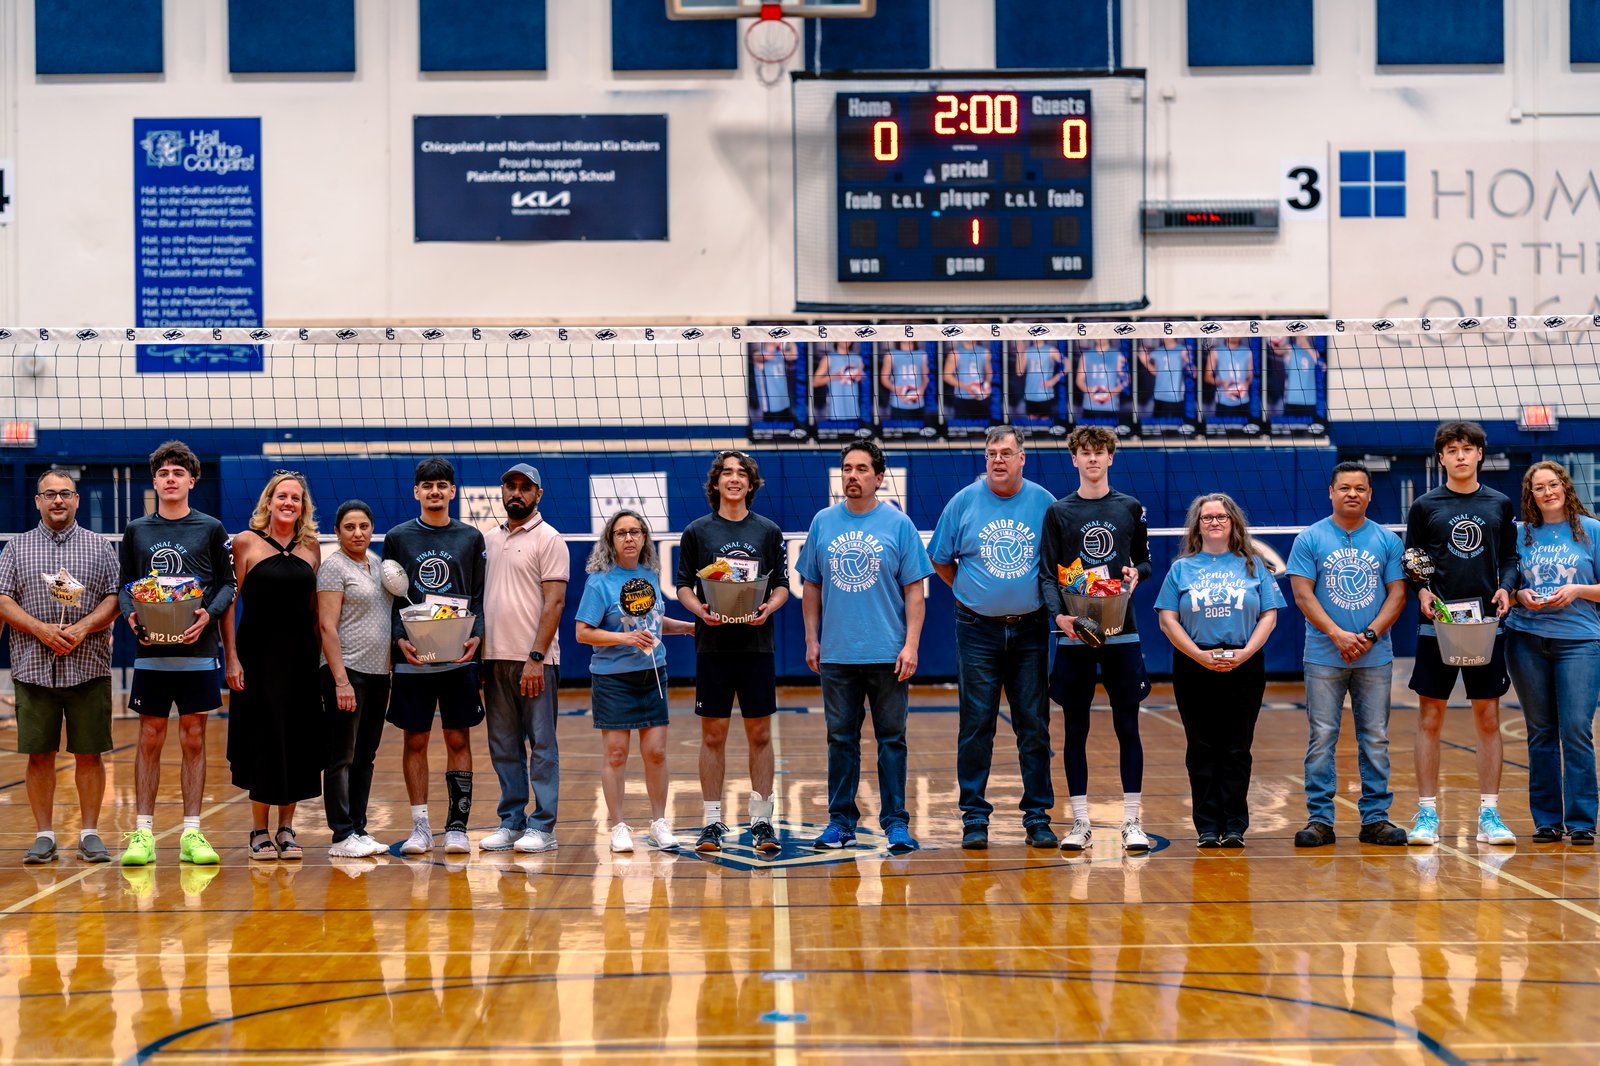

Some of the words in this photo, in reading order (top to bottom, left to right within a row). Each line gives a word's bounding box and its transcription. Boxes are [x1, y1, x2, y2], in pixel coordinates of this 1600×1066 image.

[848, 98, 892, 117] Home
[934, 94, 1018, 135] 2:00
[1031, 96, 1086, 116] Guests
[421, 140, 485, 152] Chicagoland
[486, 140, 506, 151] and
[507, 140, 561, 151] Northwest
[562, 140, 601, 151] Indiana
[601, 140, 620, 151] Kia
[621, 140, 660, 151] Dealers
[873, 121, 898, 161] 0
[1062, 118, 1087, 160] 0
[499, 158, 530, 169] Proud
[531, 158, 542, 169] to
[543, 158, 582, 171] support
[941, 159, 989, 181] period
[466, 170, 516, 182] Plainfield
[518, 170, 550, 182] South
[551, 170, 577, 184] High
[579, 170, 615, 182] School
[1286, 166, 1322, 210] 3
[1431, 168, 1600, 221] HOM
[845, 191, 882, 210] fouls
[940, 189, 989, 210] player
[1048, 188, 1084, 208] fouls
[971, 218, 980, 246] 1
[850, 257, 880, 274] won
[946, 257, 986, 275] game
[1051, 255, 1082, 271] won
[1452, 242, 1507, 276] OF
[1080, 520, 1101, 534] FINAL
[1103, 521, 1117, 532] SET
[1448, 513, 1470, 526] FINAL
[1471, 515, 1486, 526] SET
[978, 519, 1014, 540] SENIOR
[1016, 521, 1036, 540] DAD
[149, 541, 172, 553] FINAL
[174, 542, 188, 554] SET
[720, 541, 740, 554] FINAL
[743, 542, 757, 554] SET
[827, 530, 864, 553] SENIOR
[864, 533, 884, 553] DAD
[1530, 541, 1569, 555] Senior
[416, 550, 437, 563] FINAL
[439, 550, 453, 561] SET
[980, 547, 992, 556] 20
[1023, 547, 1034, 557] 25
[1323, 548, 1358, 569] SENIOR
[1361, 550, 1380, 569] DAD
[870, 559, 880, 569] 25
[984, 561, 1006, 579] FINISH
[1006, 562, 1032, 580] STRONG
[831, 574, 852, 593] FINISH
[852, 574, 878, 593] STRONG
[1197, 568, 1236, 580] Senior
[1325, 576, 1336, 586] 20
[1368, 576, 1378, 586] 25
[1328, 592, 1350, 610] FINISH
[1351, 592, 1376, 611] STRONG
[1205, 606, 1232, 618] 2025
[149, 632, 165, 641] #12
[167, 633, 184, 643] Log
[1105, 624, 1122, 636] Alex
[1449, 656, 1461, 665] #7
[1462, 655, 1486, 665] Emilio
